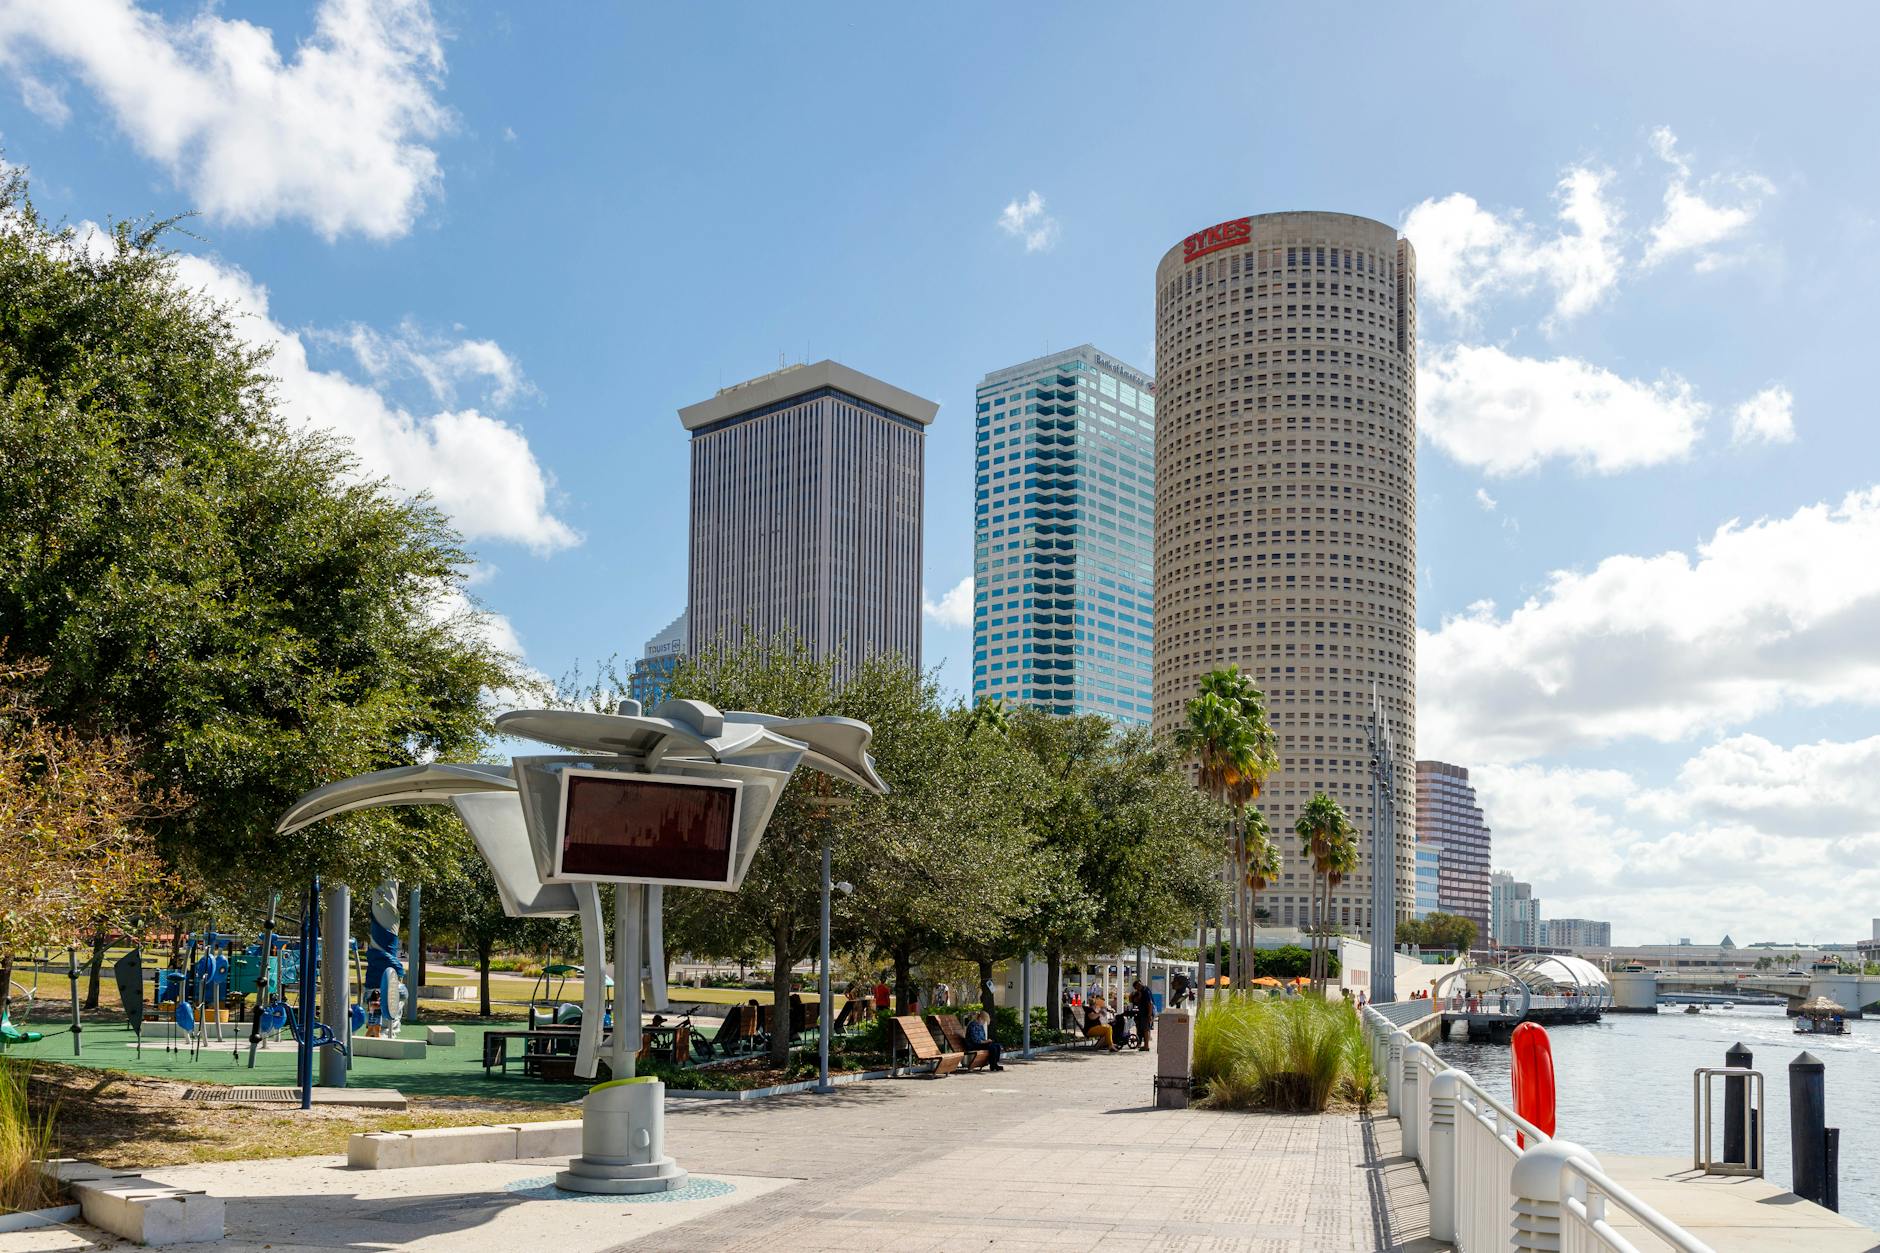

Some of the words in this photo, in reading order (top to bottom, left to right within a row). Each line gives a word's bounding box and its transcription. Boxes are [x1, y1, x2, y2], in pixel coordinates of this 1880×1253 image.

[1184, 217, 1251, 255] SYKES
[1095, 354, 1113, 371] Bank
[1120, 366, 1144, 385] America
